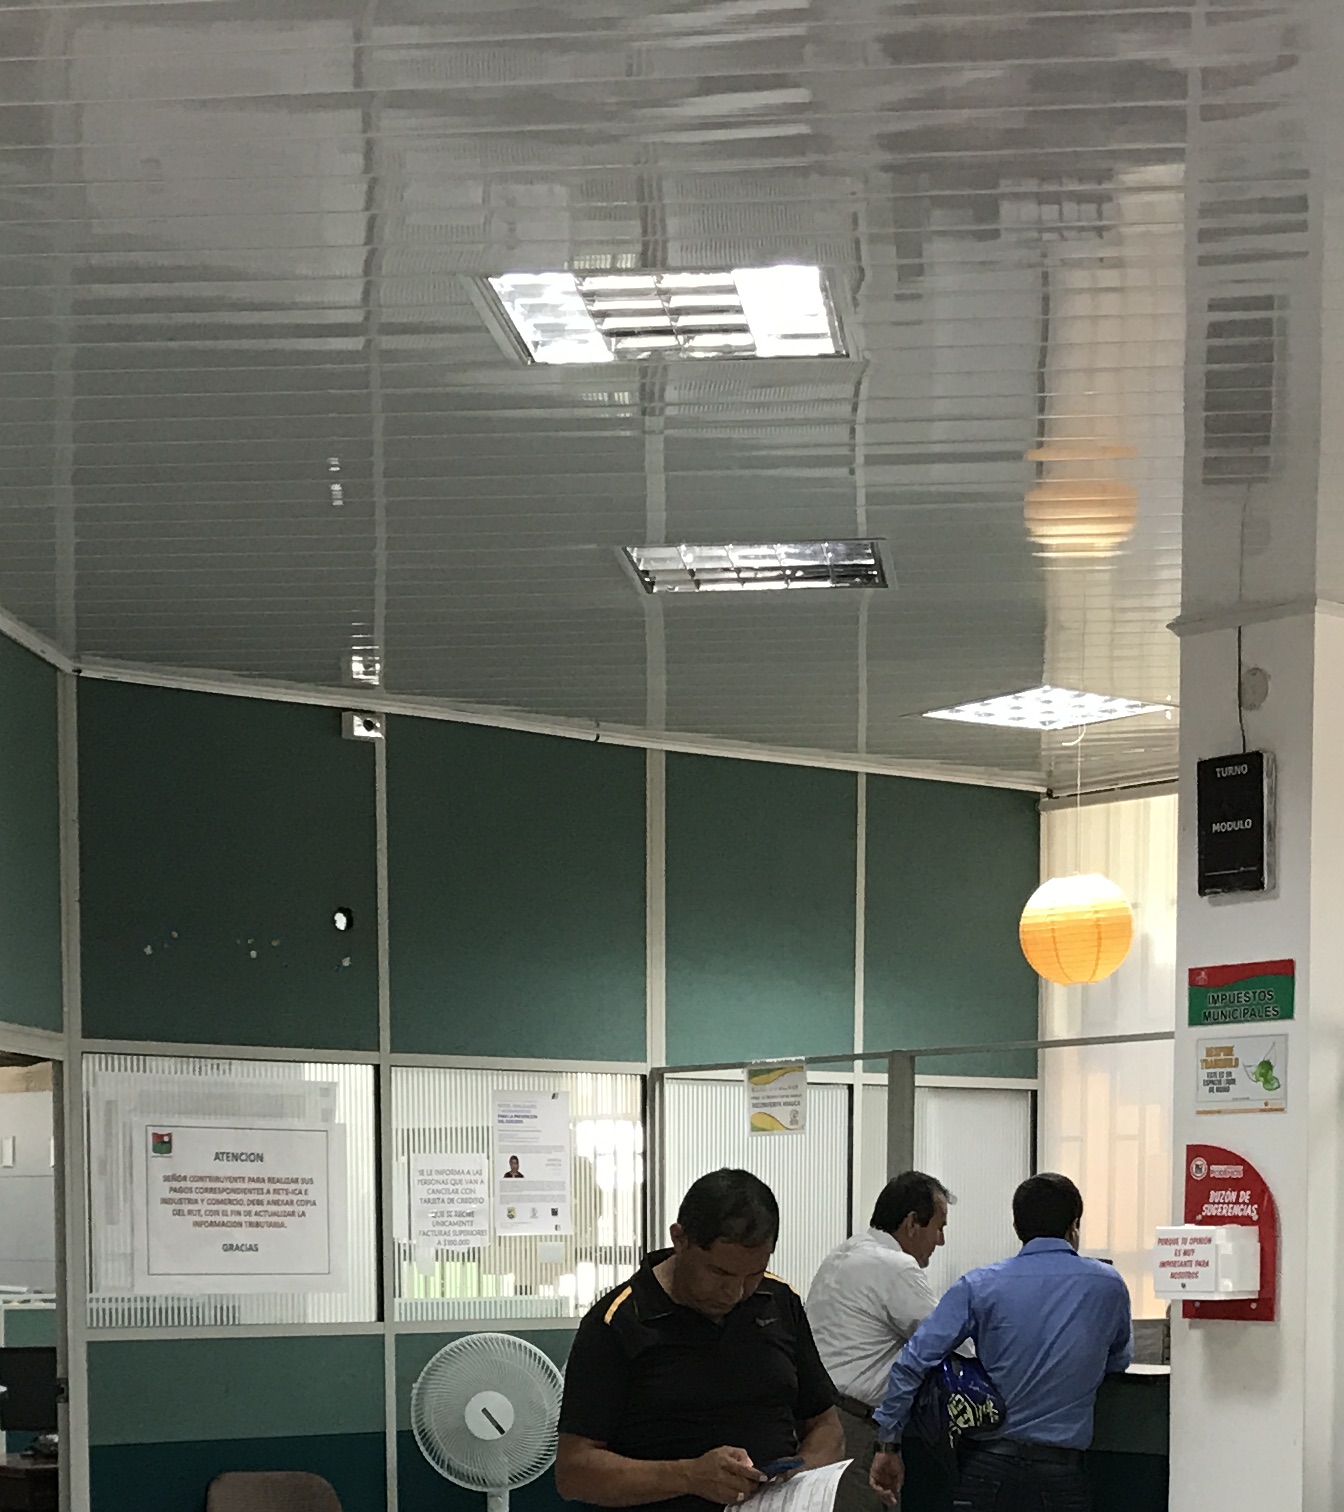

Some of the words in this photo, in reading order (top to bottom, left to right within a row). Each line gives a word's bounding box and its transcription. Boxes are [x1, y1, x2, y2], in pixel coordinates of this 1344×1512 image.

[1216, 764, 1249, 778] TURNO
[1212, 818, 1253, 834] MODULO
[1208, 989, 1274, 1006] IMPUESTOS
[1203, 1006, 1280, 1022] MUNICIPALES
[213, 1151, 265, 1163] ATENCION
[1209, 1187, 1238, 1203] BUZÓN
[1238, 1190, 1252, 1203] DE
[1201, 1203, 1258, 1217] SUGERENCIAS
[221, 1243, 259, 1252] GRACIAS
